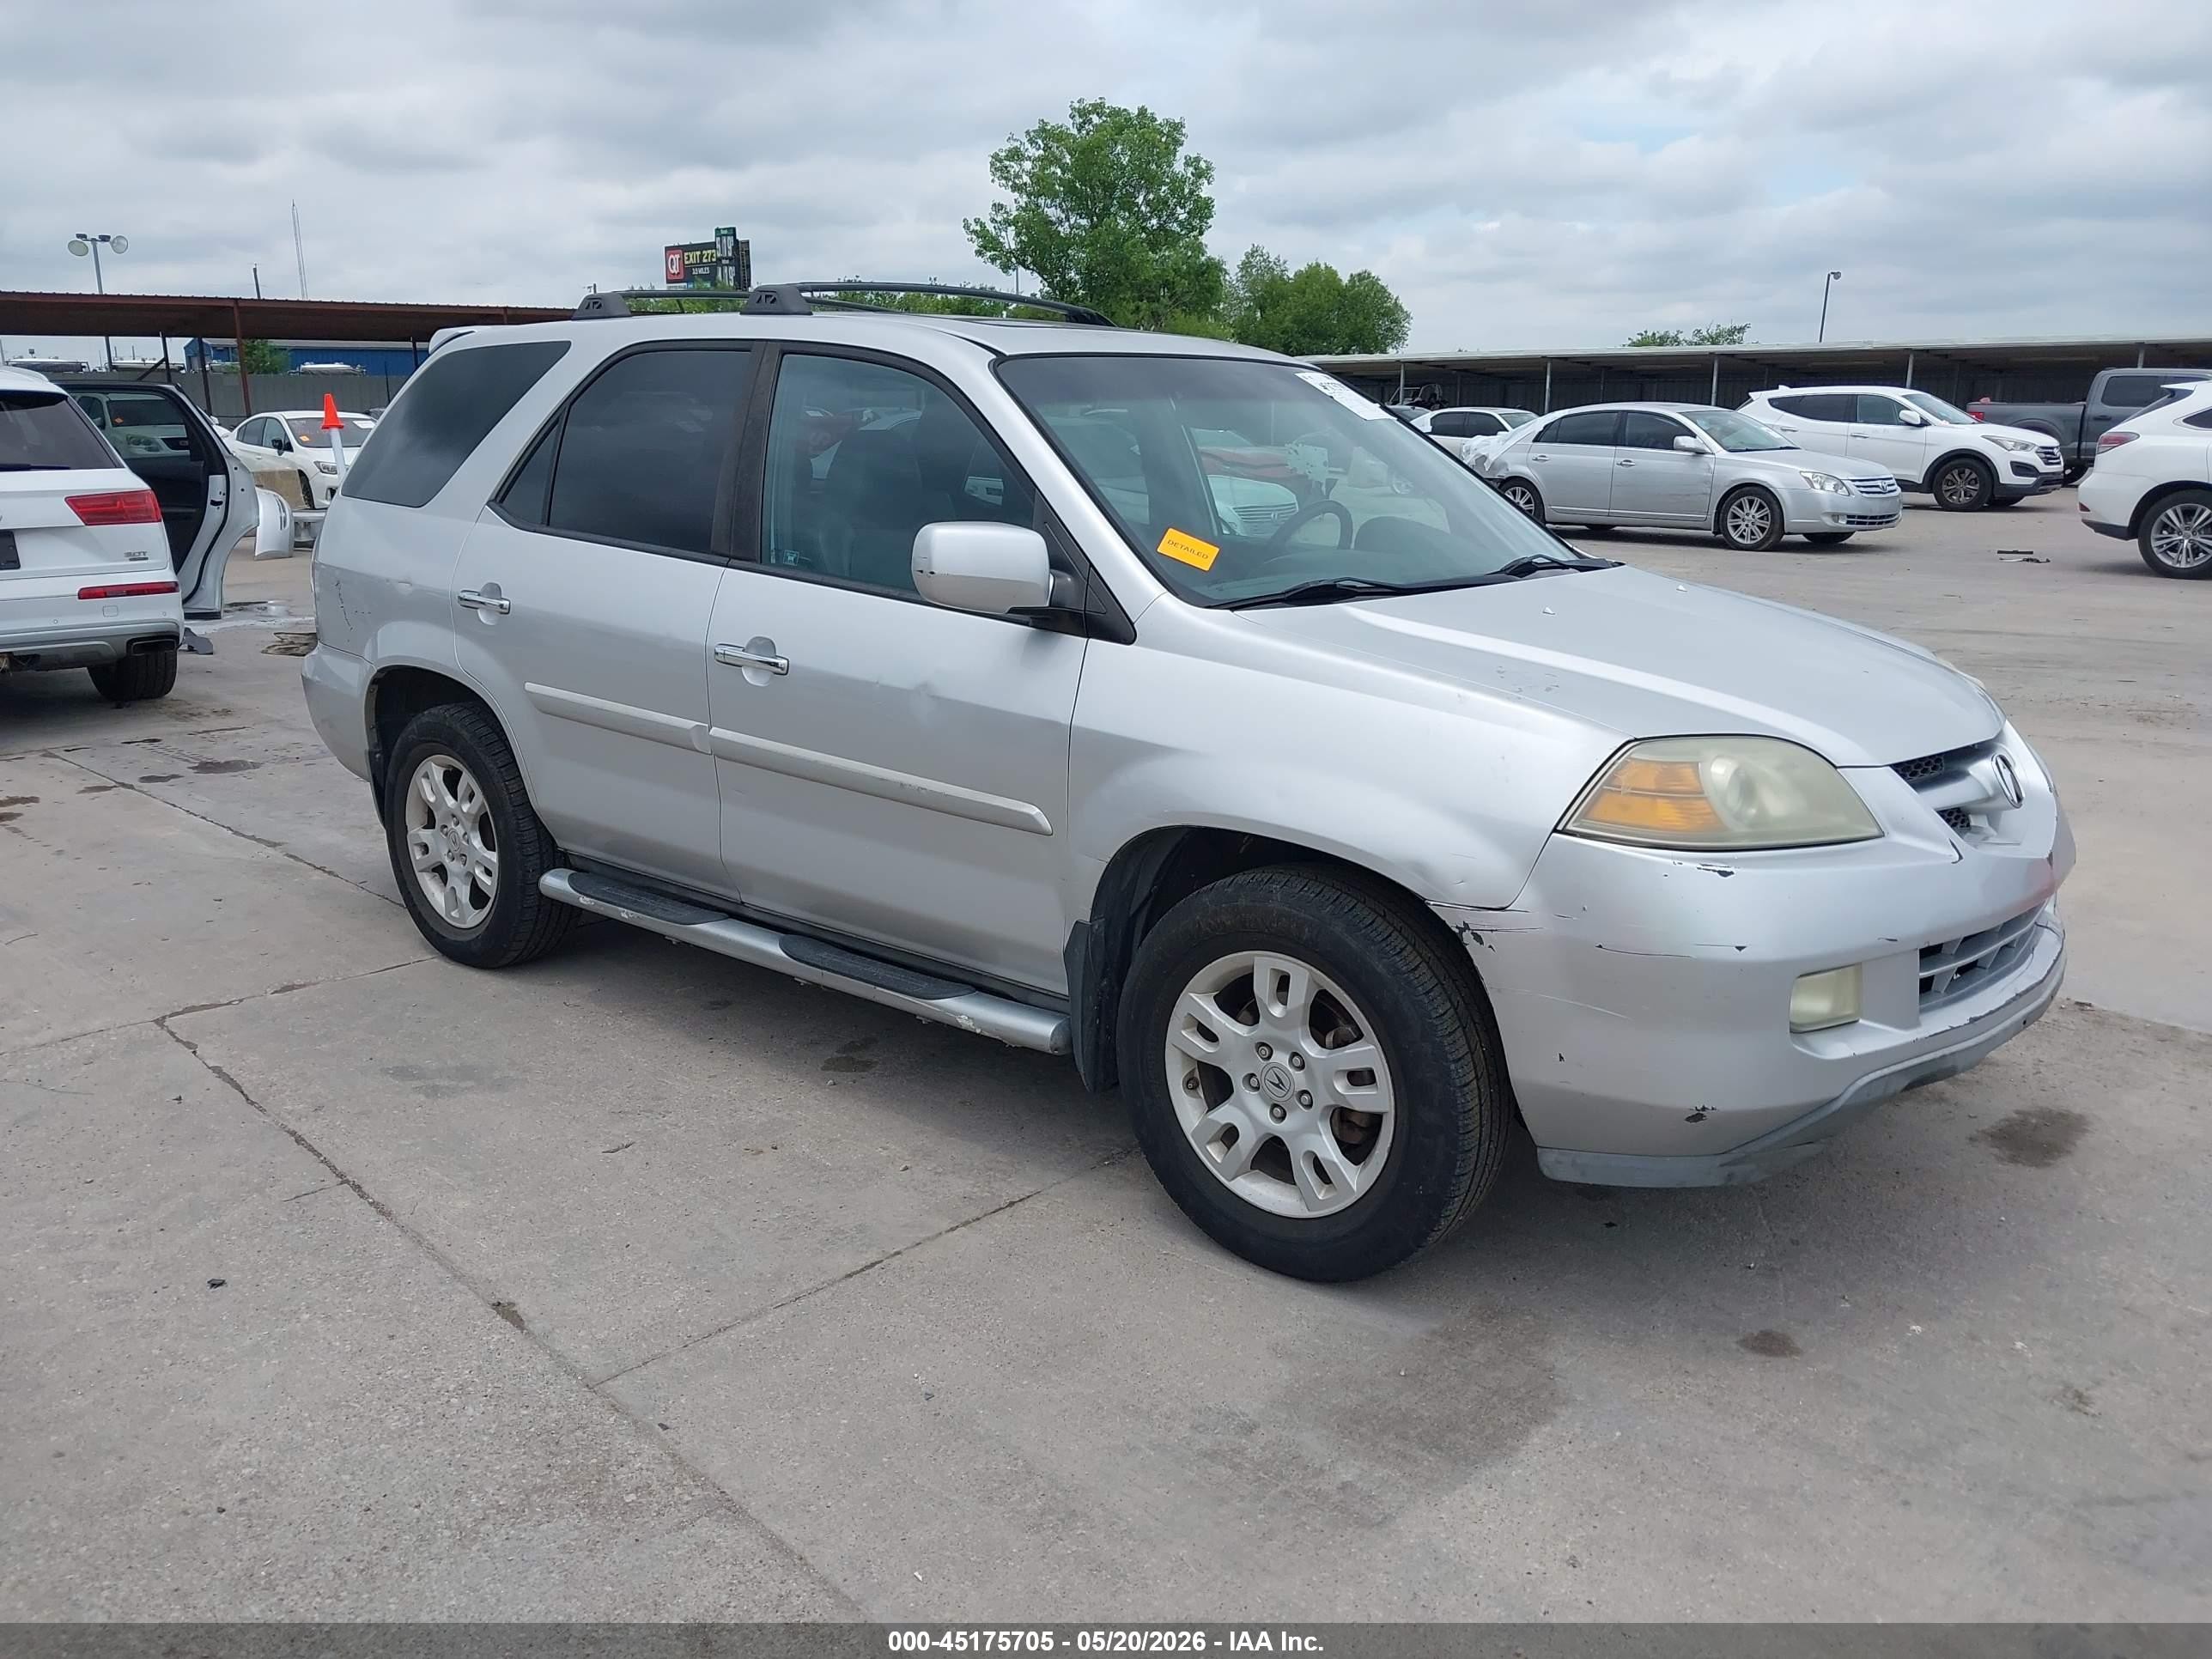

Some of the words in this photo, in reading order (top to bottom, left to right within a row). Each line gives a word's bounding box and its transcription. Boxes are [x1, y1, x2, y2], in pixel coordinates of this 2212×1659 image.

[668, 253, 680, 275] QT
[684, 251, 702, 264] EXIT
[702, 249, 716, 263] 273
[1167, 539, 1209, 560] DETAILED
